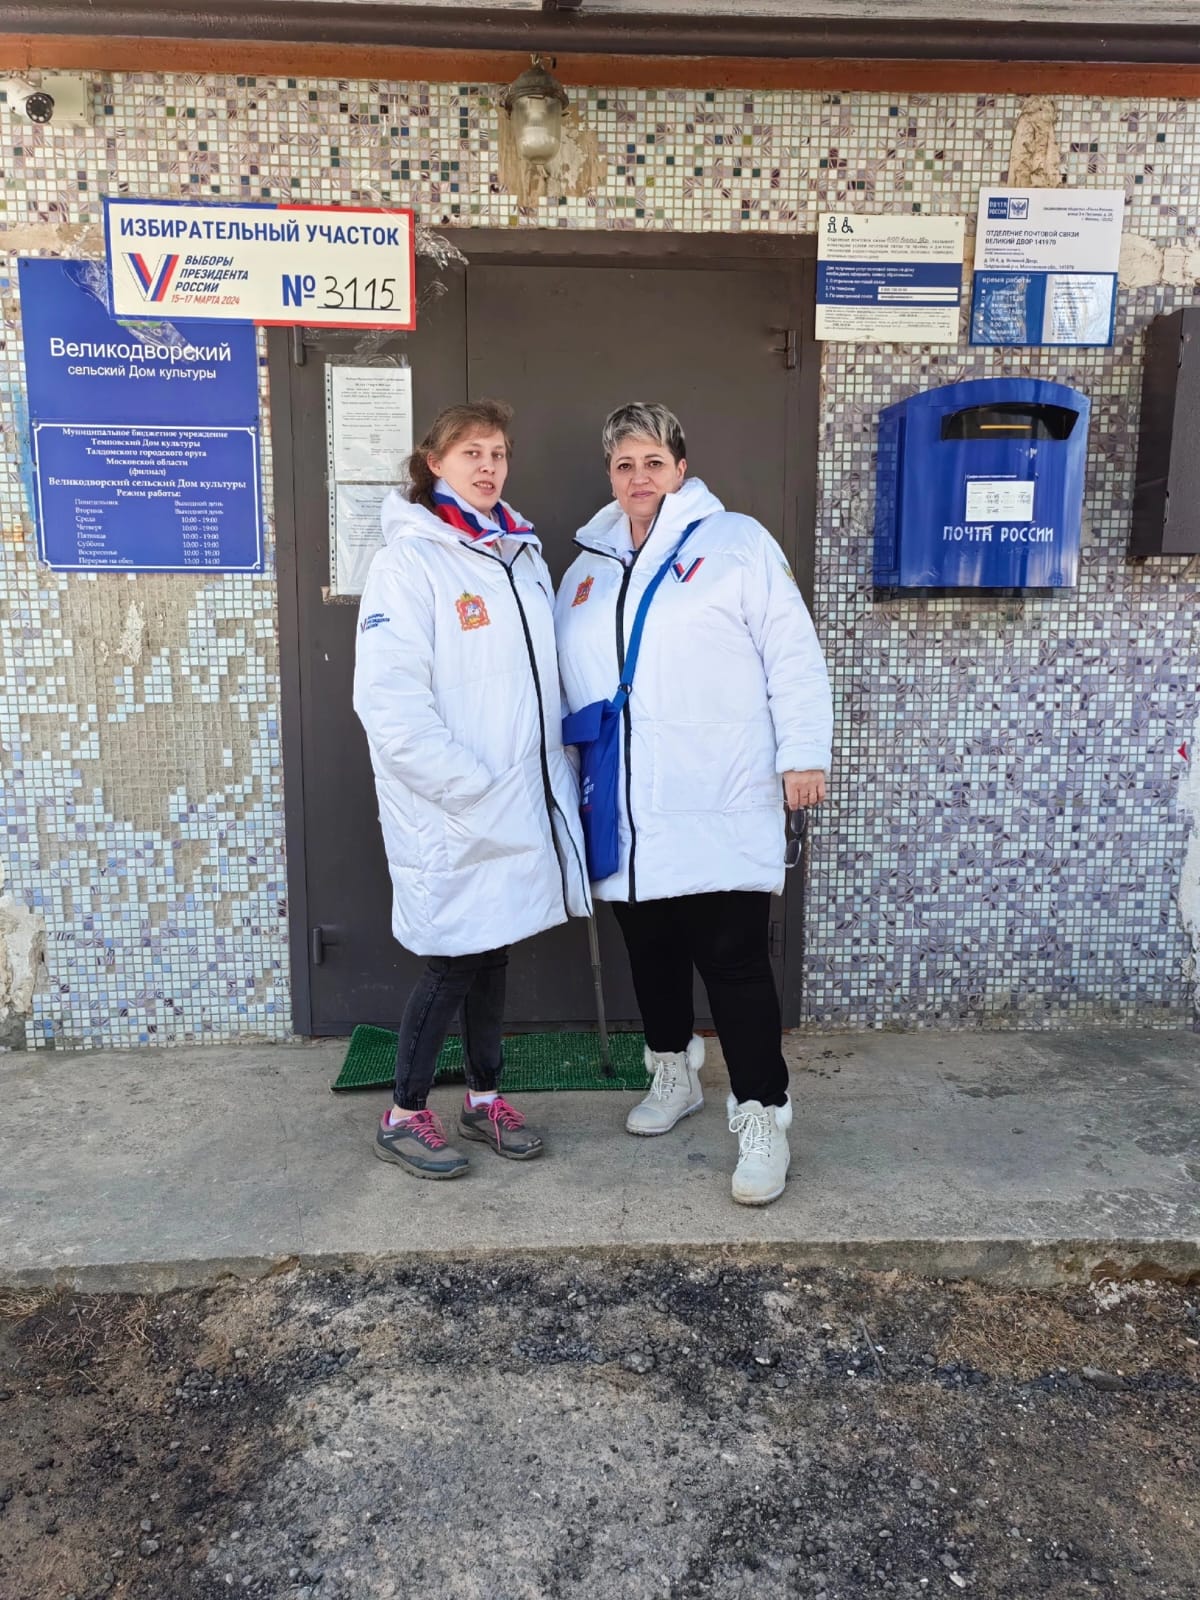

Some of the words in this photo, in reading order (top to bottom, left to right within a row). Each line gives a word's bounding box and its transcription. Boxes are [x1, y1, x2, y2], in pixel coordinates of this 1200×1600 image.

[120, 217, 300, 242] ИЗБИРАТЕЛЬНЫЙ
[307, 223, 400, 246] УЧАСТОК
[986, 230, 1023, 238] ОТДЕЛЕНИЕ
[985, 237, 1015, 245] ВЕЛИКИЙ
[185, 255, 234, 266] ВЫБОРЫ
[180, 268, 249, 280] ПРЕЗИДЕНТА
[1005, 276, 1031, 285] работы
[175, 281, 219, 292] РОССИИ
[281, 274, 315, 307] №
[323, 276, 396, 309] 3115
[193, 295, 220, 304] МАРТА
[221, 296, 240, 304] 2024
[50, 337, 231, 364] Великодворский
[67, 364, 126, 377] сельский
[129, 365, 156, 379] Дом
[159, 367, 217, 381] культуры
[62, 428, 130, 438] Муниципальное
[131, 429, 177, 438] бюджетное
[178, 431, 228, 439] учреждение
[142, 439, 159, 447] Дом
[139, 450, 183, 458] городского
[106, 457, 155, 466] Московской
[128, 467, 166, 476] (филиал)
[49, 477, 130, 488] Великодворский
[131, 479, 176, 488] сельский
[177, 479, 198, 488] Дом
[200, 481, 247, 490] культуры
[116, 489, 146, 497] Режим
[147, 489, 181, 499] работы:
[75, 515, 96, 523] Среда
[943, 526, 992, 542] ПОЧТА
[1001, 527, 1054, 542] РОССИИ
